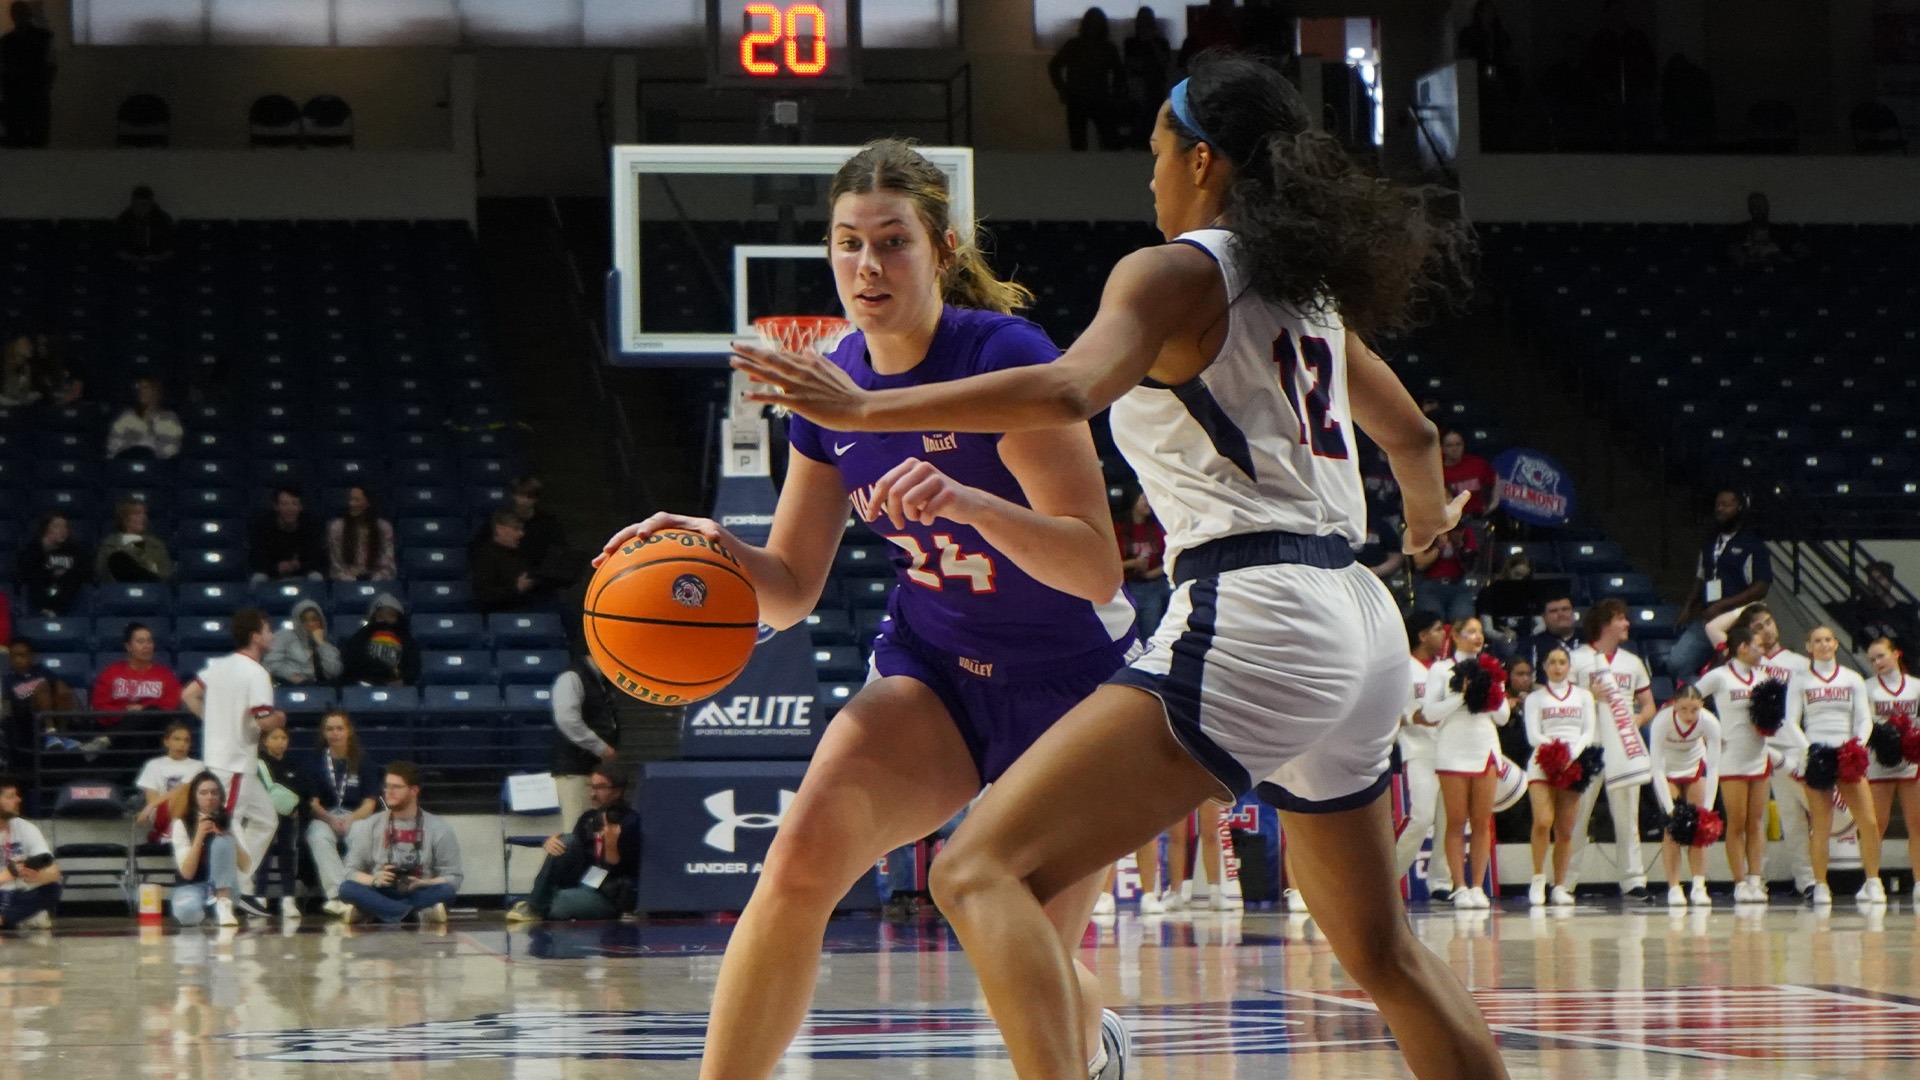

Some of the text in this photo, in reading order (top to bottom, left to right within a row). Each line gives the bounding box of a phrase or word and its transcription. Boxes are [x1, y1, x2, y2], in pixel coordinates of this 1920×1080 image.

[740, 3, 826, 75] 20
[1272, 326, 1349, 460] 12
[922, 432, 958, 453] VALLEY
[885, 532, 997, 595] 24
[959, 656, 993, 677] VALLEY
[1806, 687, 1852, 705] BELMONT
[728, 696, 814, 726] ELITE
[1541, 706, 1582, 719] BELMONT
[687, 862, 748, 873] UNDER
